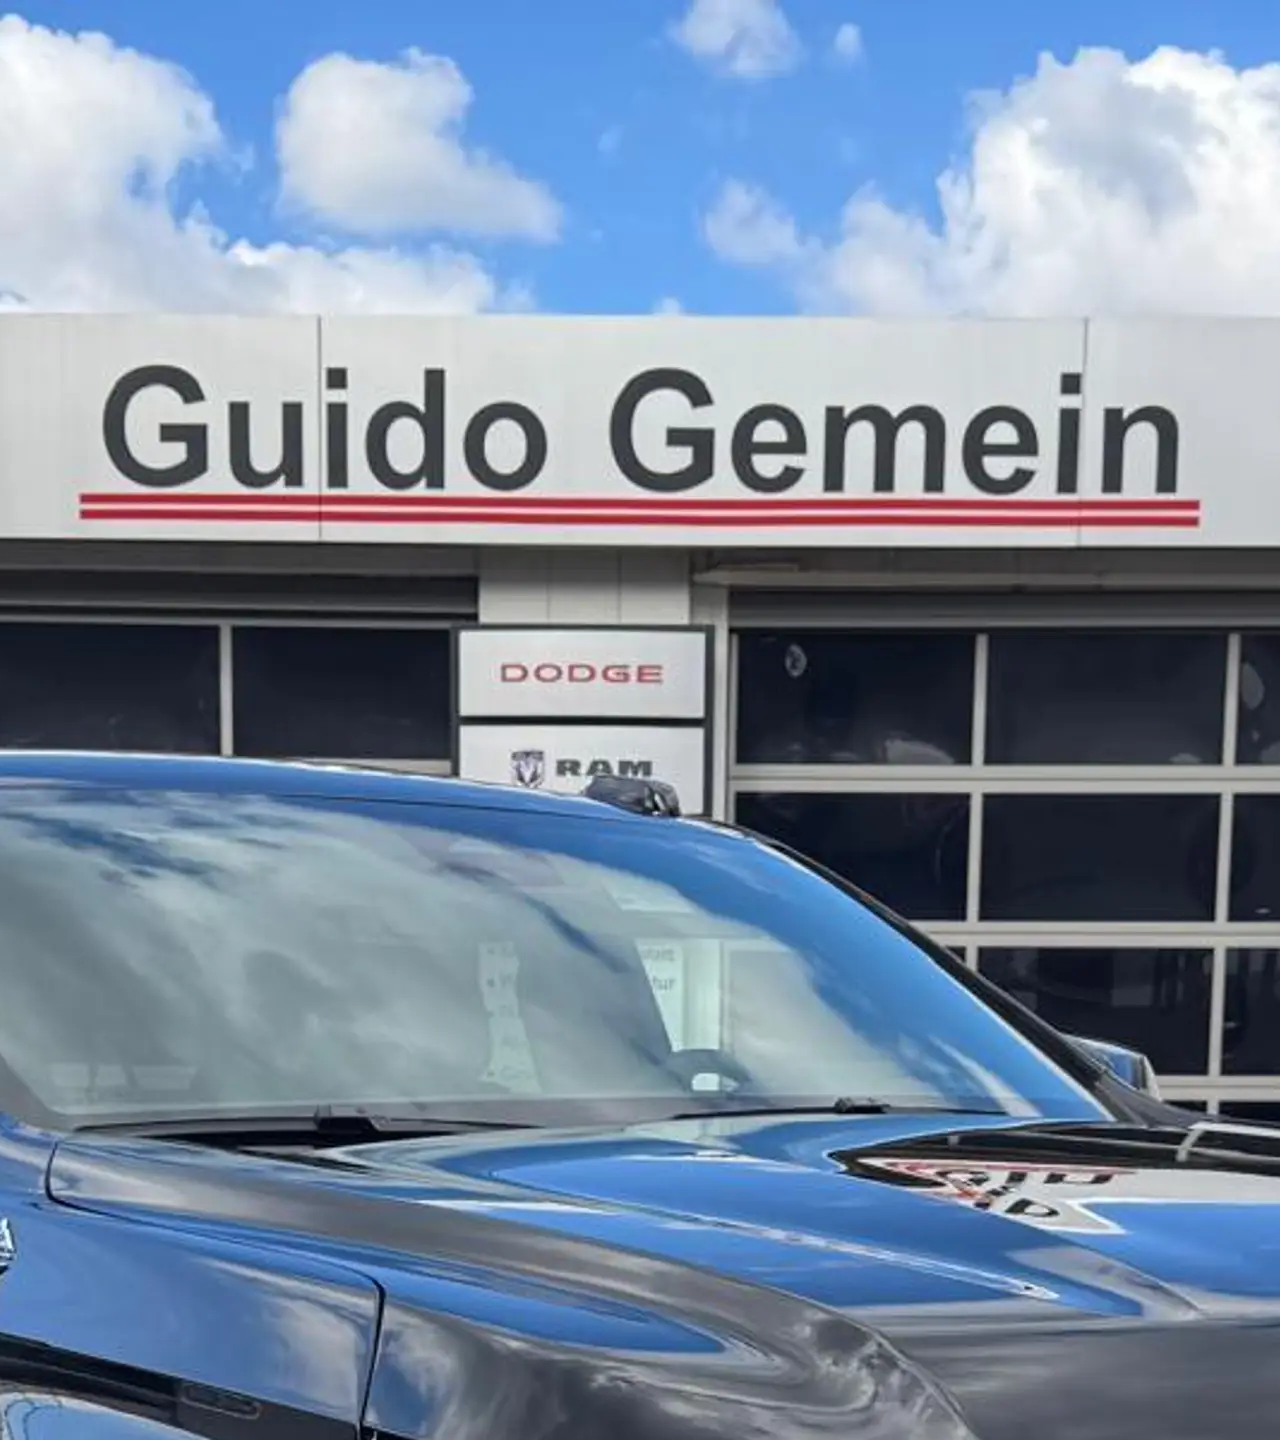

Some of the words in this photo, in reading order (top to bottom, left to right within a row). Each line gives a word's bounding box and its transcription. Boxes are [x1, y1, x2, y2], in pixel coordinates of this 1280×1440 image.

[102, 364, 548, 492] Guido
[609, 367, 1180, 496] Gemein
[500, 663, 663, 684] DODGE
[556, 759, 653, 777] RAM
